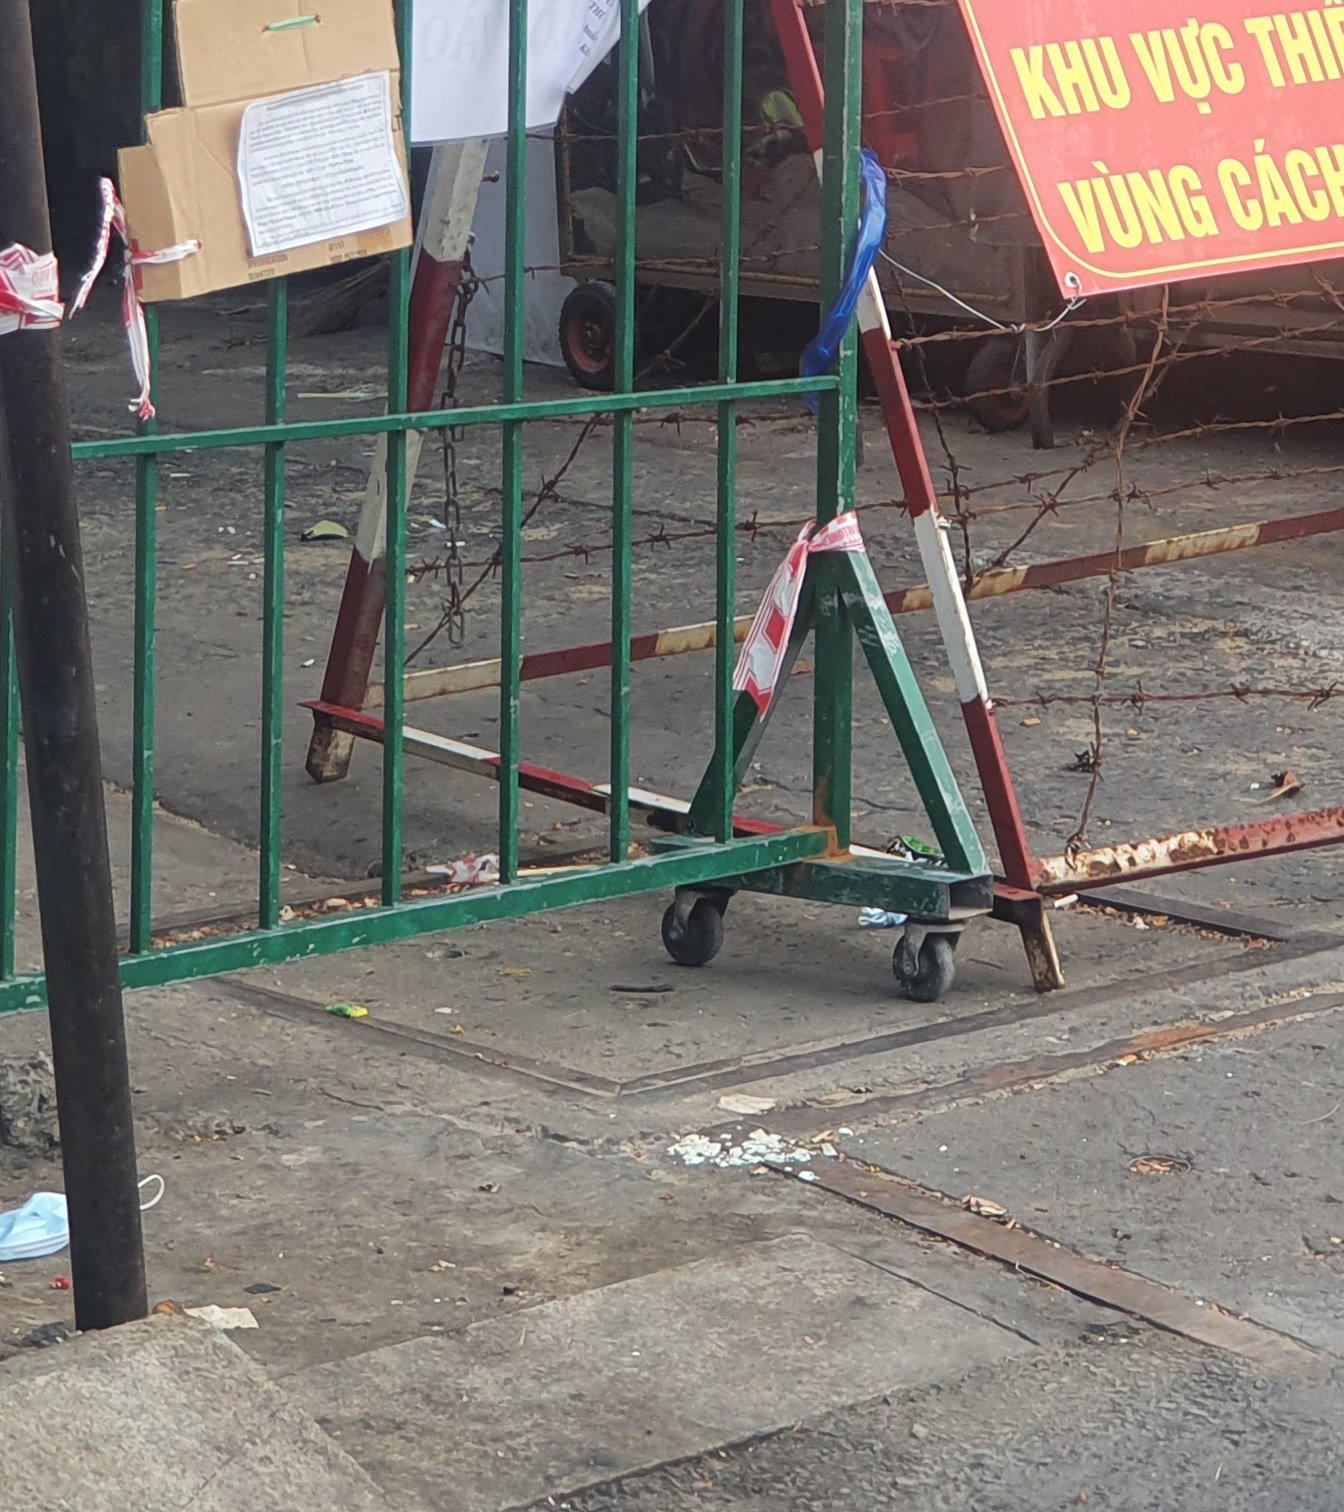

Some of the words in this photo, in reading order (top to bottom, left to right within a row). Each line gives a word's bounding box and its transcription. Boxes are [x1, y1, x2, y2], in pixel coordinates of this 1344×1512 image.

[1010, 35, 1132, 120] KHU
[1128, 17, 1246, 115] VỰC
[1057, 160, 1219, 255] VÙNG
